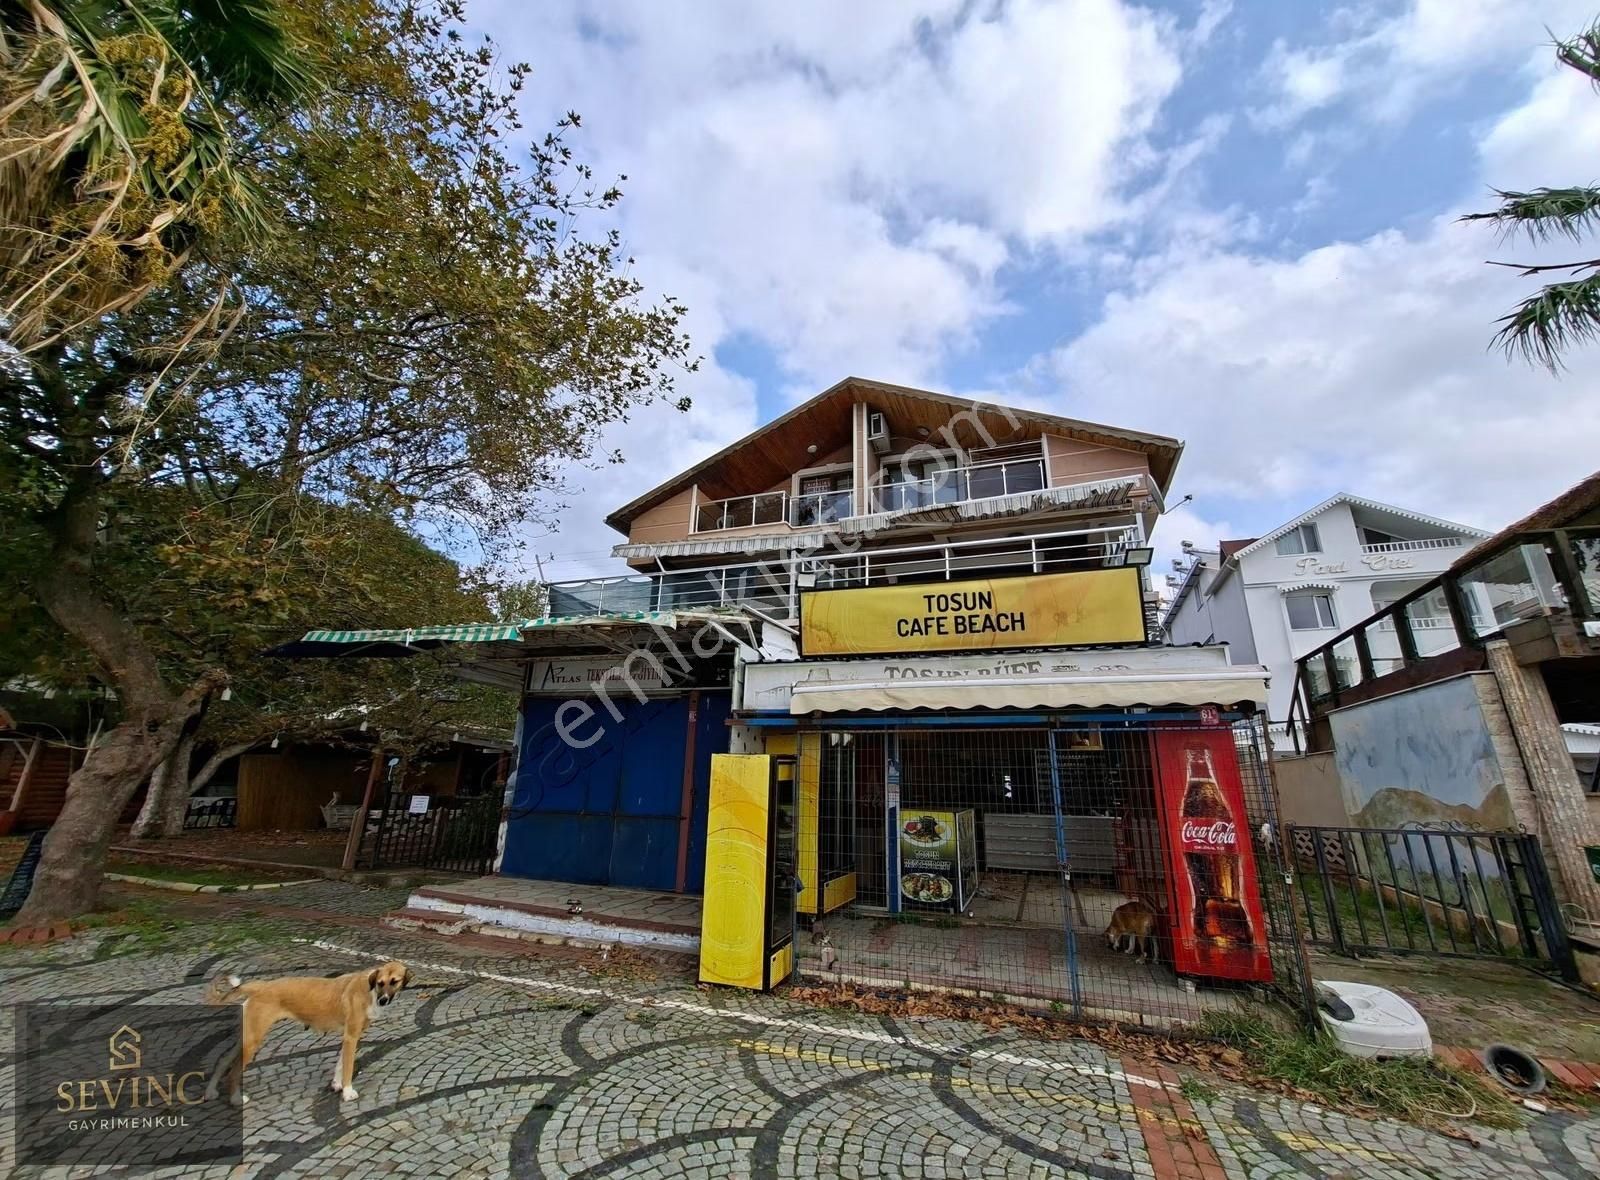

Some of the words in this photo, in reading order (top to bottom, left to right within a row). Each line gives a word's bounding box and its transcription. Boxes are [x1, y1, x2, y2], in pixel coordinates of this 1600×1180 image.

[923, 590, 993, 614] TOSUN
[897, 615, 949, 638] CAFE
[954, 611, 1026, 635] BEACH
[1181, 820, 1236, 845] Coca-Cola
